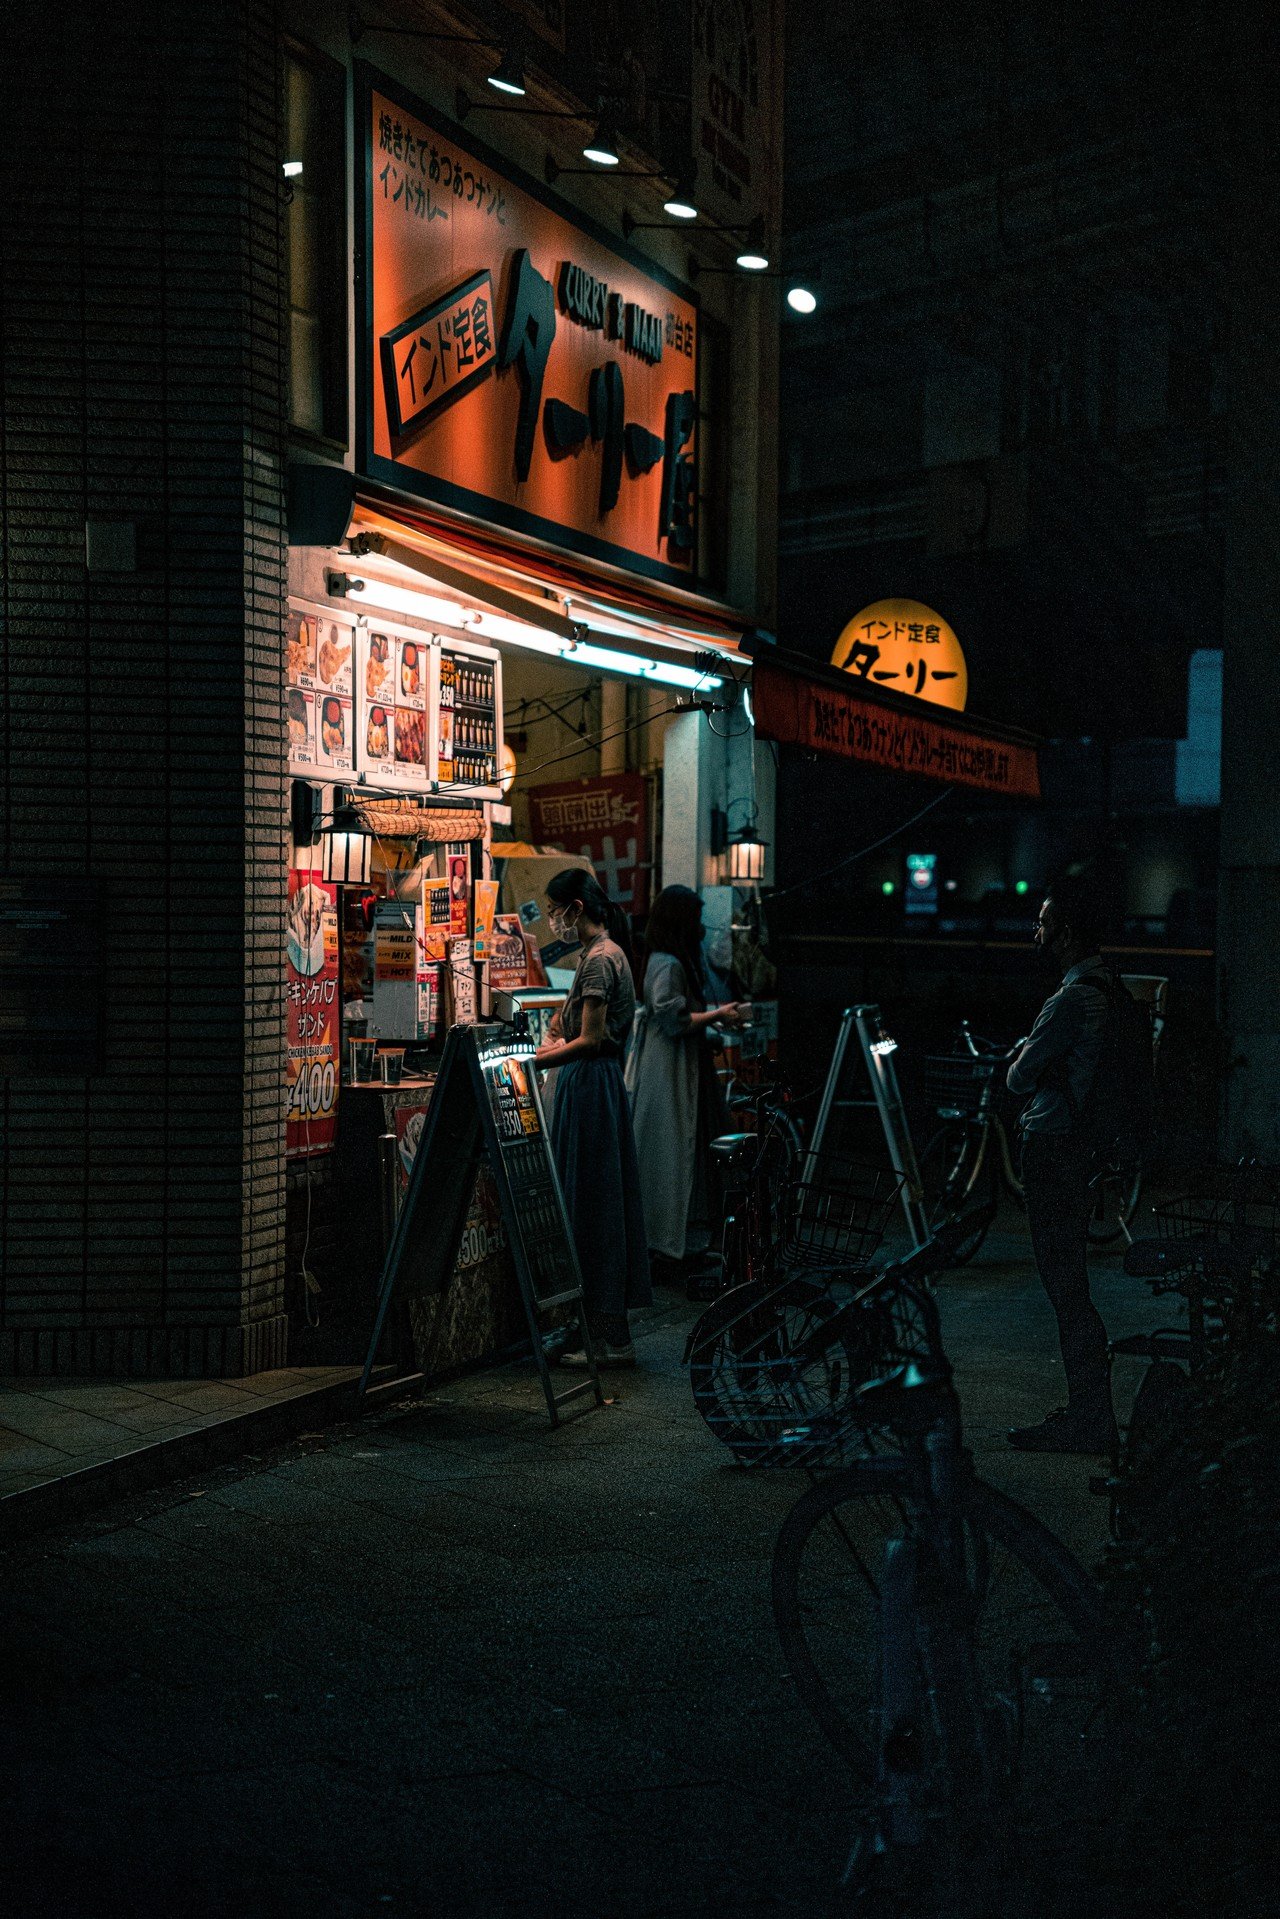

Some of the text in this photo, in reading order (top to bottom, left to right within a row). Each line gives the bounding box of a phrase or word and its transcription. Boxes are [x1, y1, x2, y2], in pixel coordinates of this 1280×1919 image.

[379, 110, 506, 225] 焼きたてあつあつナンと
[379, 162, 449, 223] インドカレー
[564, 263, 607, 328] CURRY
[629, 304, 663, 363] NAAN
[401, 296, 492, 405] インド定食
[861, 620, 942, 644] インド定食
[842, 638, 959, 694] ターリー
[390, 934, 413, 943] MILD
[391, 951, 412, 960] MIX
[390, 967, 412, 976] HOT
[298, 1012, 326, 1038] サンド
[287, 1047, 306, 1060] CHICKEN
[284, 1060, 336, 1118] ¥400
